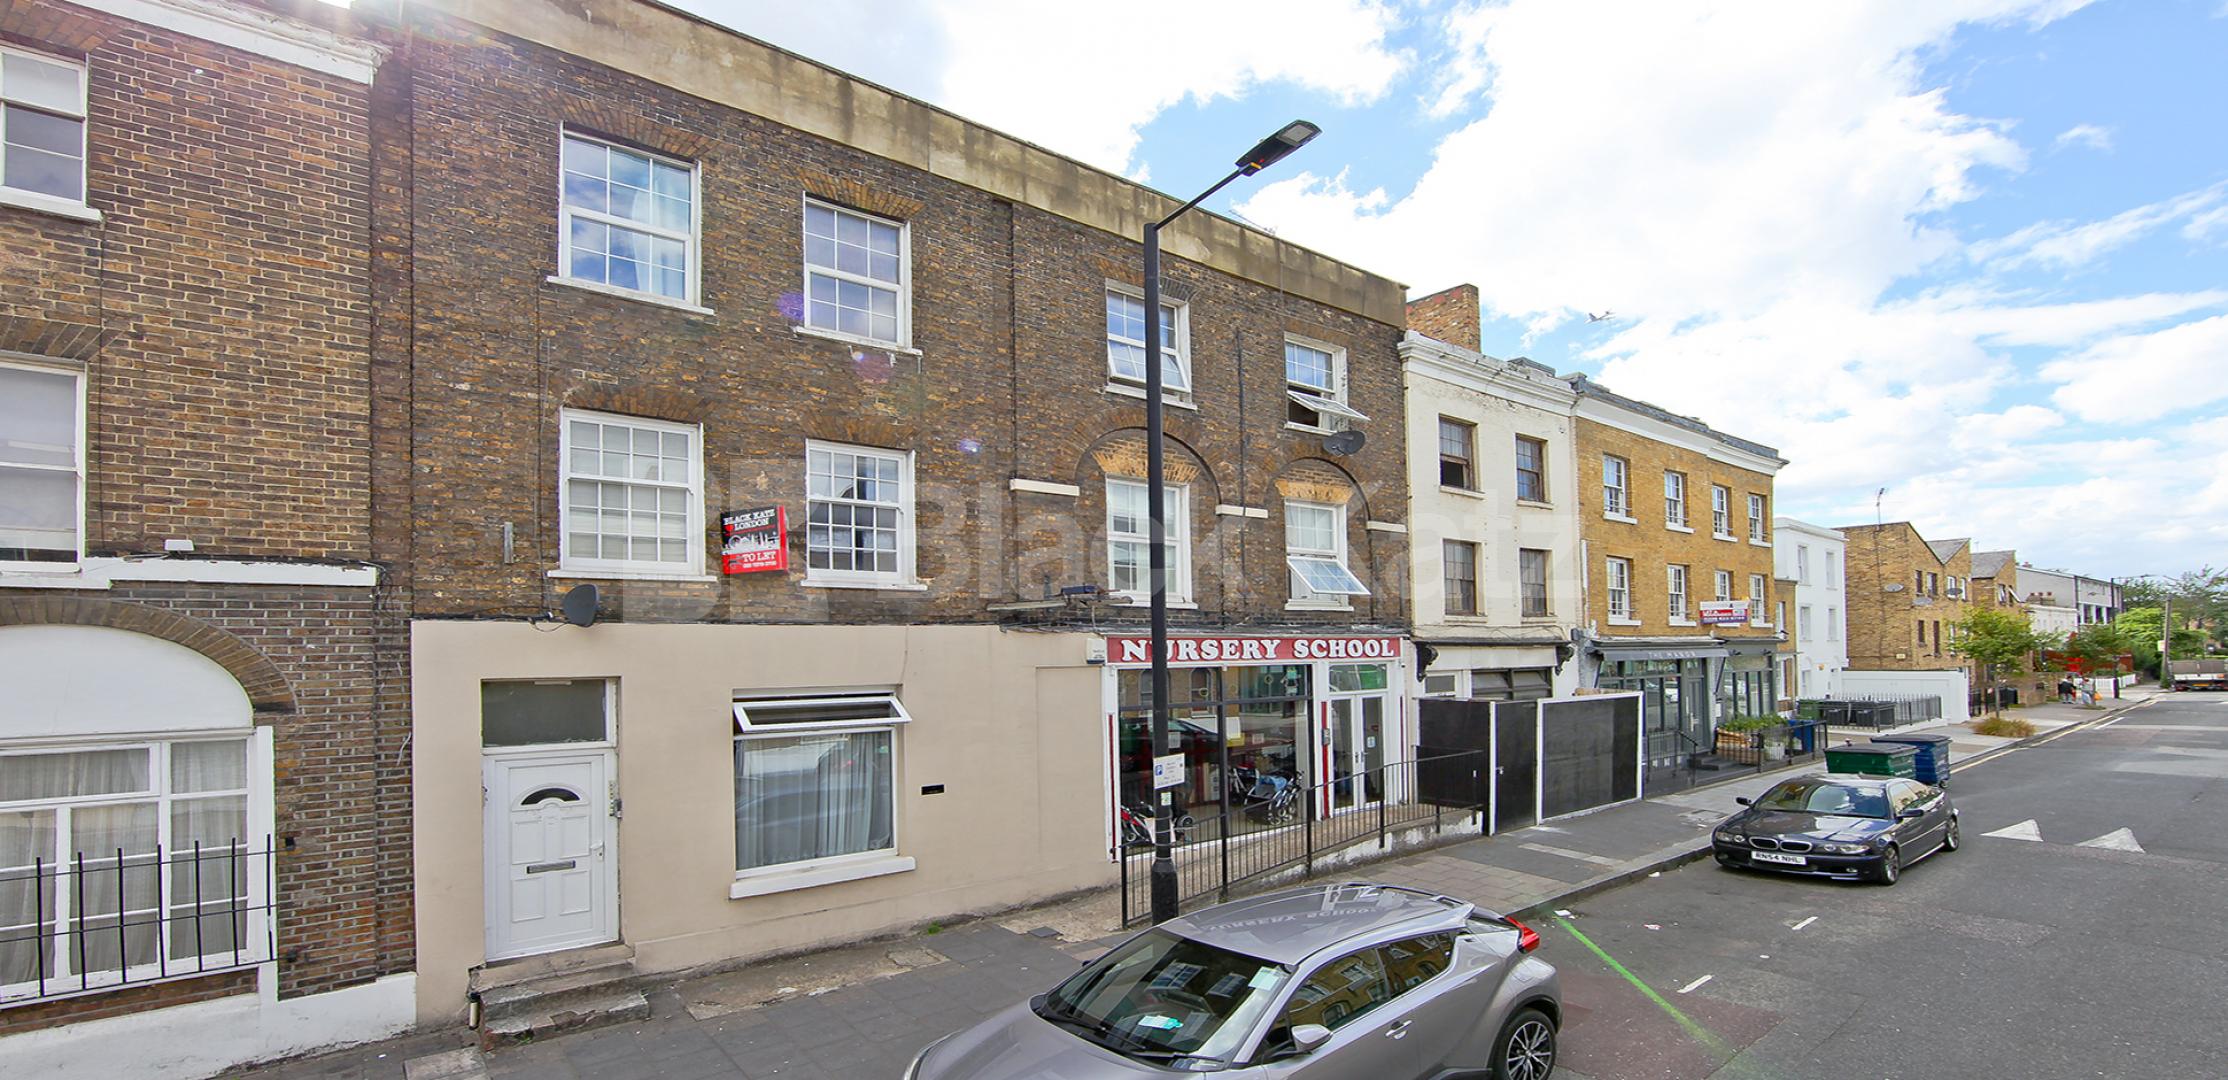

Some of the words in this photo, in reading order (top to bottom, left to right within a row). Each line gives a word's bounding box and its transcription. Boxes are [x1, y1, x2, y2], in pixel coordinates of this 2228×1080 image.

[723, 514, 752, 525] BLACK
[753, 509, 776, 519] KATZ
[734, 518, 769, 531] LONDON
[742, 553, 756, 562] TO
[757, 551, 776, 561] LET
[1293, 639, 1394, 658] SCHOOL
